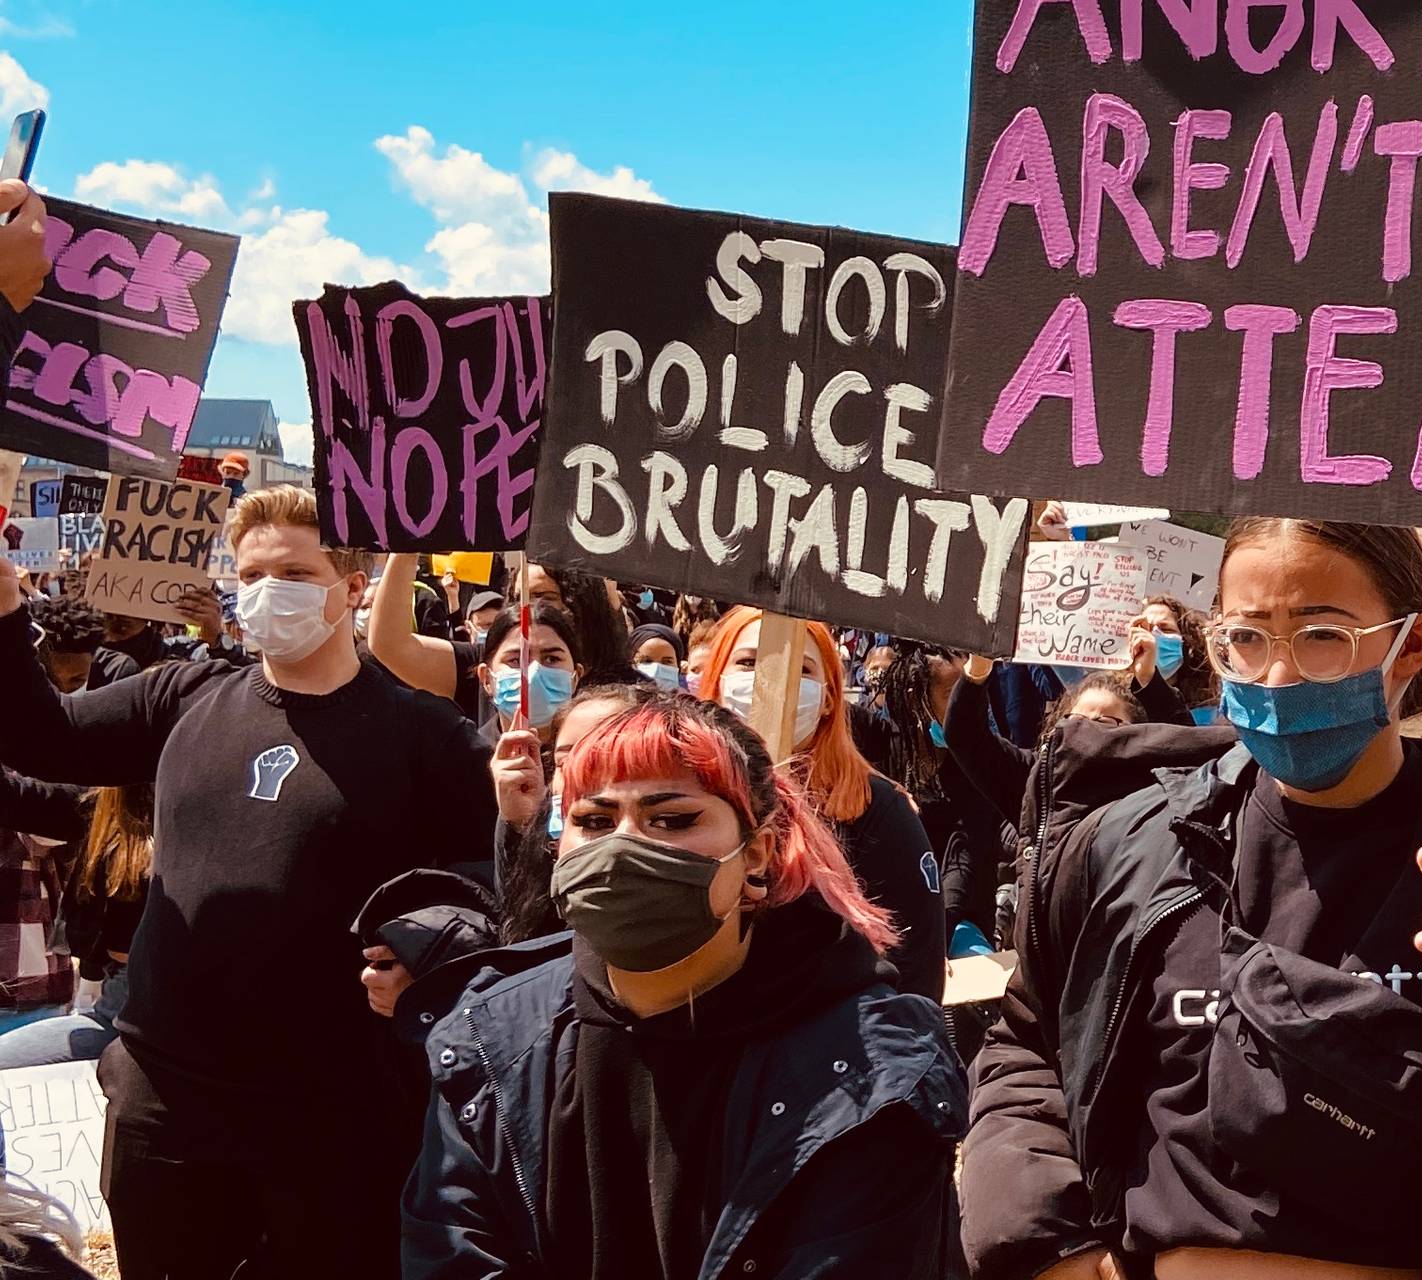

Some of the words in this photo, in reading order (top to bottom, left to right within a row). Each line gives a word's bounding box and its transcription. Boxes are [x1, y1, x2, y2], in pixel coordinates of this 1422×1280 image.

[706, 230, 947, 356] STOP
[307, 291, 444, 438] NO
[584, 329, 937, 488] POLICE
[116, 477, 221, 524] FUCK
[102, 519, 215, 571] RACISM
[563, 443, 1028, 624] BRUTALITY
[92, 571, 144, 604] AKA
[1019, 602, 1077, 626] their
[1038, 623, 1119, 657] Name
[1303, 1091, 1376, 1140] carhartt
